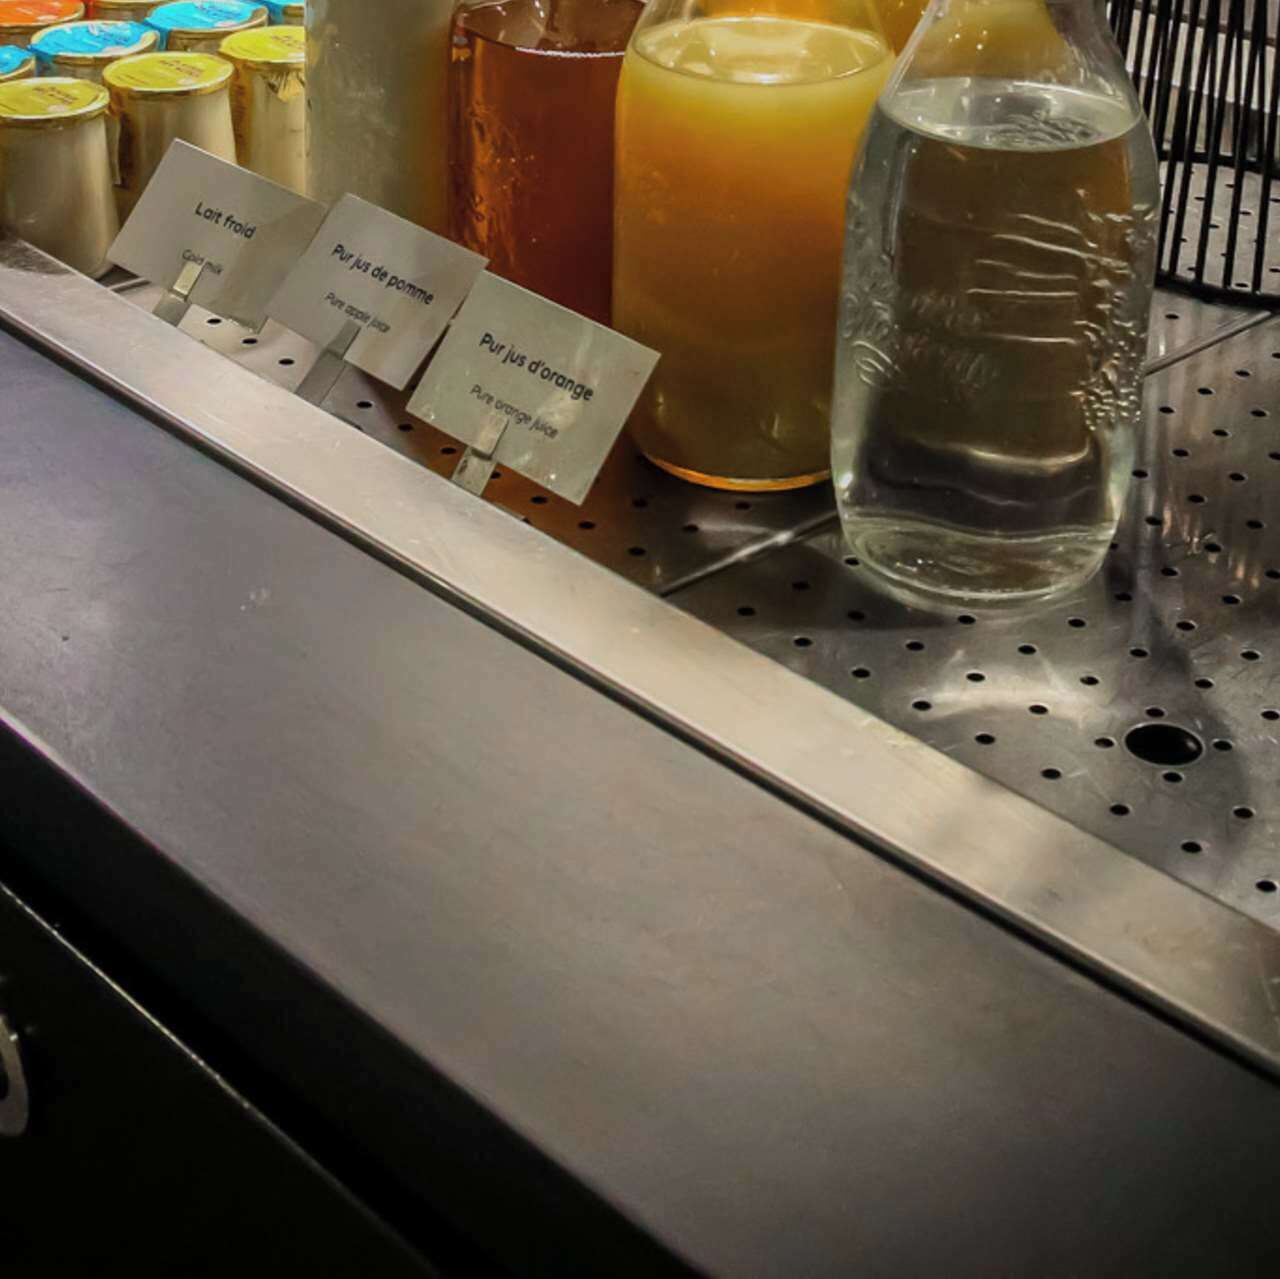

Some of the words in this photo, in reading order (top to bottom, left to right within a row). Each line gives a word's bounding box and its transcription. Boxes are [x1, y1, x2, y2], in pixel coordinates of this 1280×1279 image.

[195, 201, 223, 225] Lait
[223, 215, 257, 239] froid
[324, 291, 345, 310] Pure
[330, 243, 354, 263] Pur
[349, 255, 372, 273] jus
[371, 265, 389, 281] de
[385, 275, 434, 305] pomme
[479, 332, 506, 355] Pur
[501, 344, 527, 367] jus
[528, 360, 594, 401] d'orange
[470, 383, 495, 405] Pure
[494, 399, 532, 424] orange
[528, 417, 558, 439] juice
